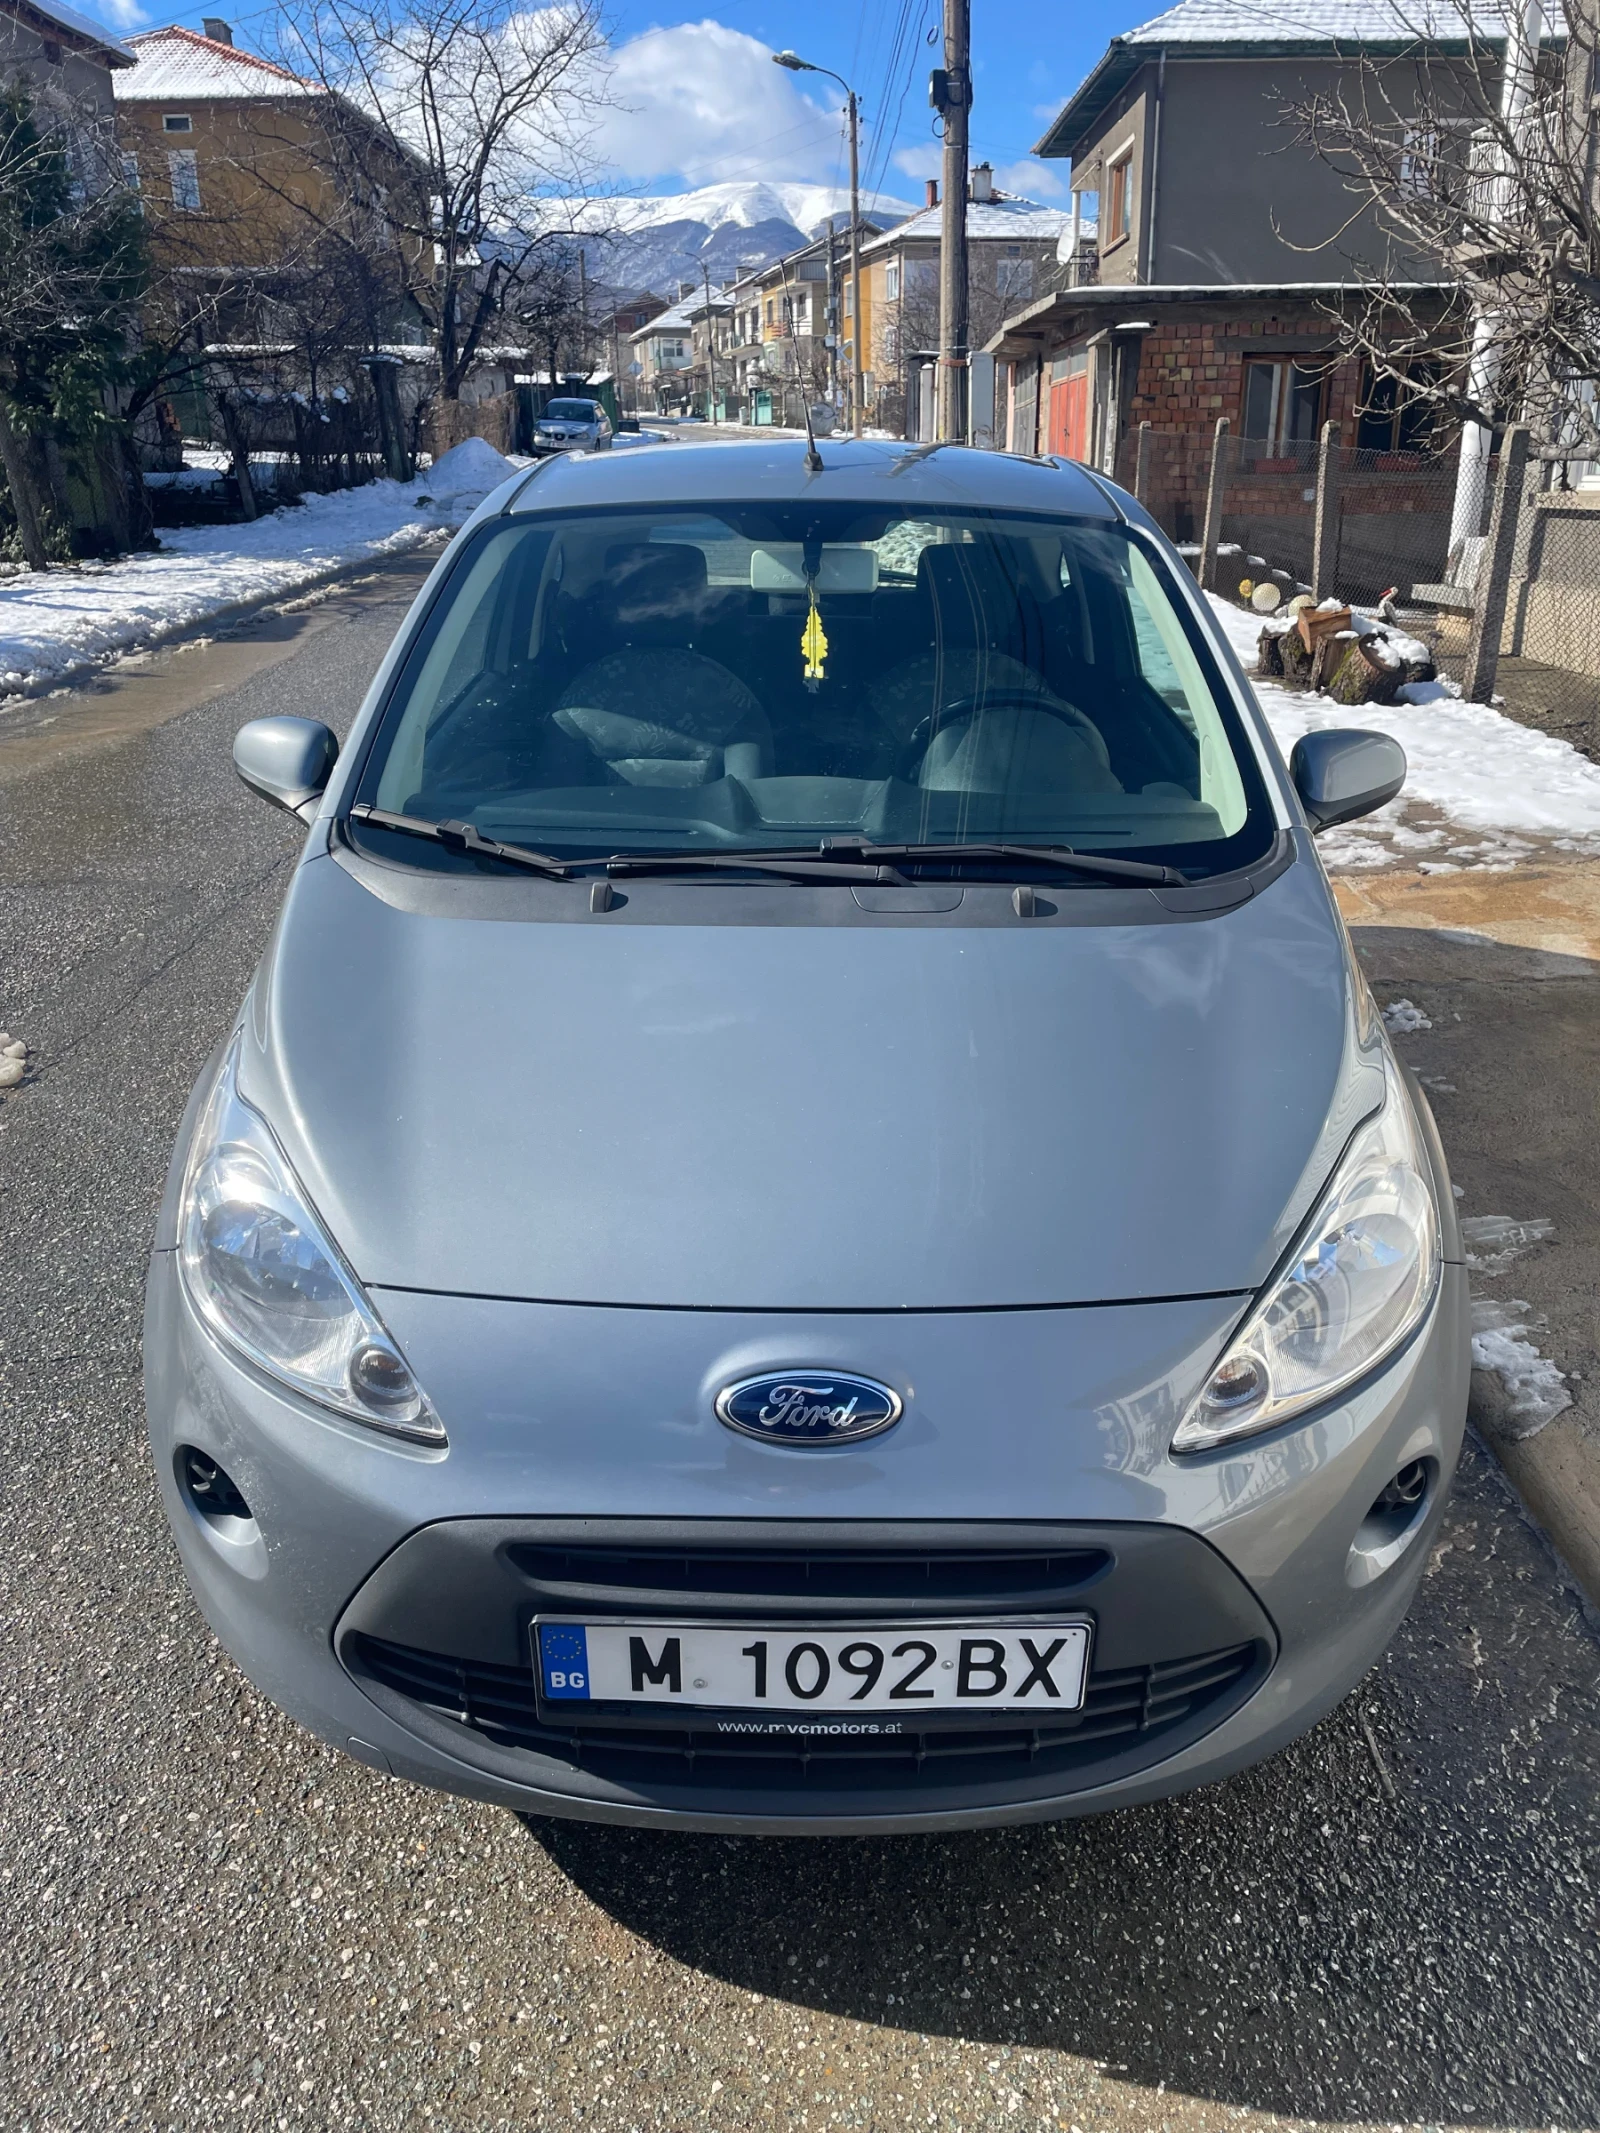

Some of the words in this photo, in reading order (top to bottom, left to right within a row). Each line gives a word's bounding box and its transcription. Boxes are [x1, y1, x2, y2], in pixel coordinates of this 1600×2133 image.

[758, 1384, 859, 1427] Ford
[550, 1671, 585, 1689] BG
[628, 1636, 682, 1693] M
[741, 1640, 938, 1700] 1092
[956, 1637, 1069, 1698] BX
